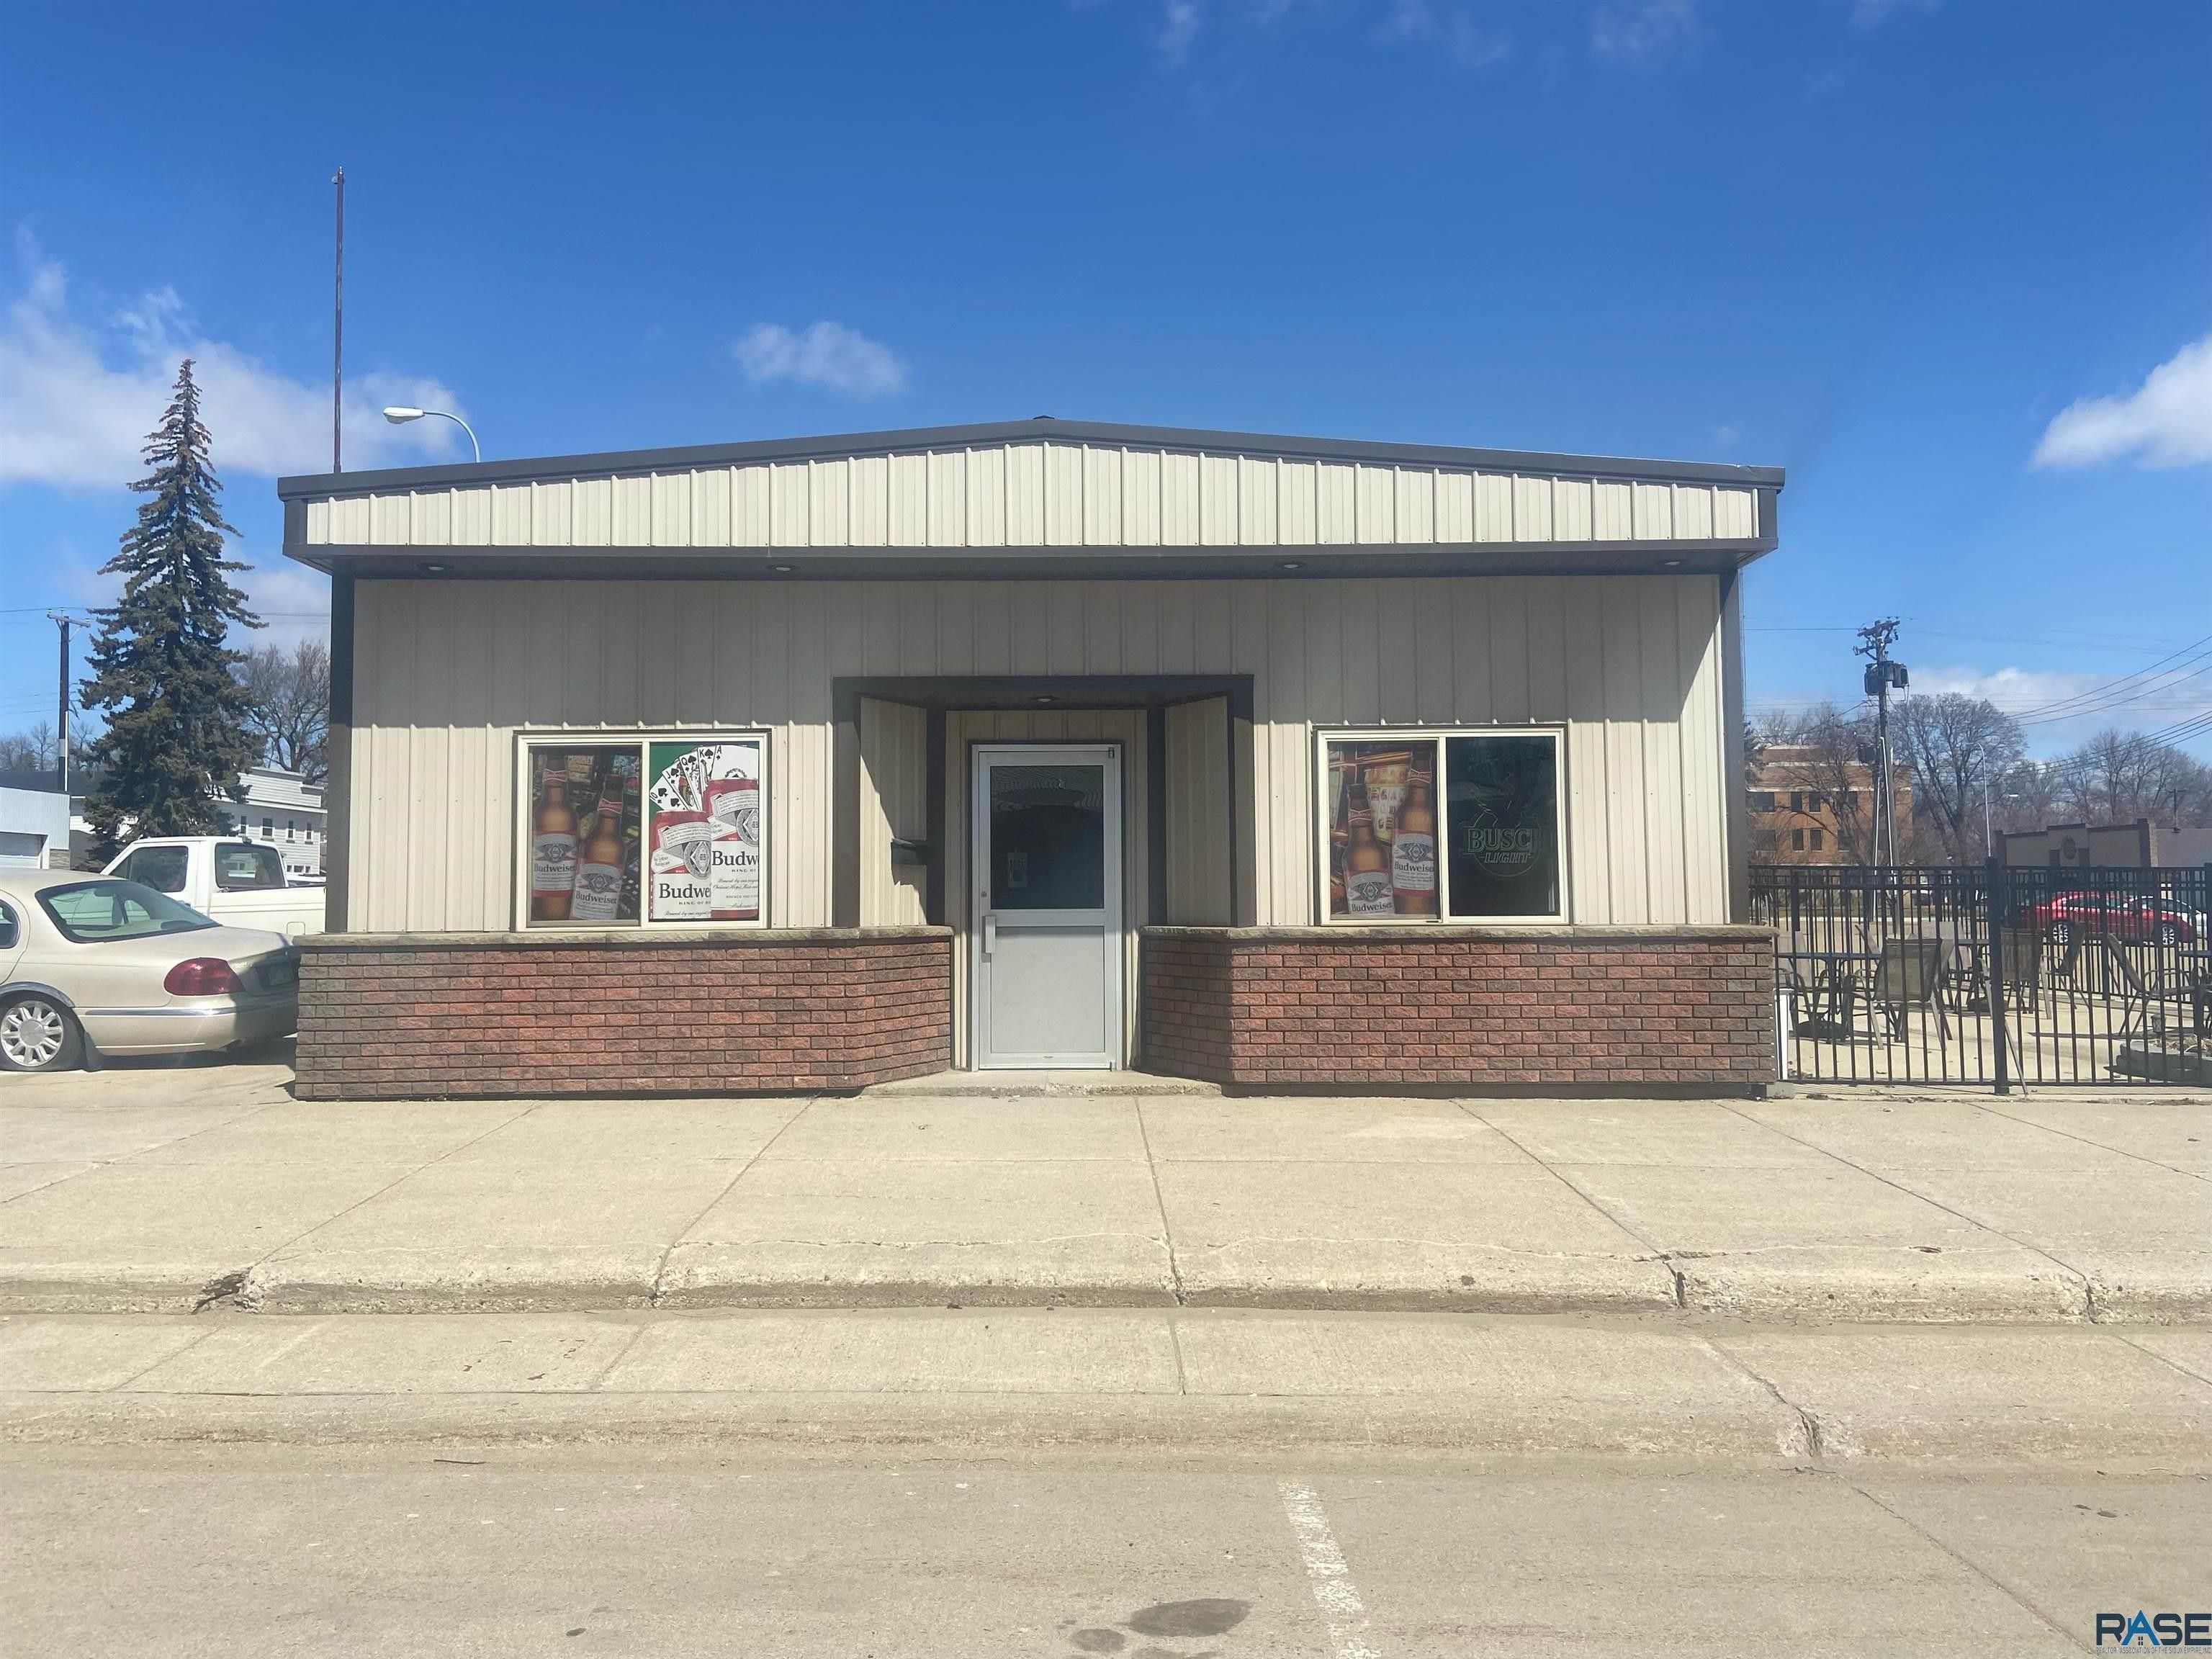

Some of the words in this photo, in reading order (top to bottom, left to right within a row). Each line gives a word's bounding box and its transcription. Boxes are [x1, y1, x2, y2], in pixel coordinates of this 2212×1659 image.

[699, 749, 705, 757] K
[681, 757, 689, 765] Q
[665, 770, 671, 779] J
[1467, 829, 1542, 852] BUSCH
[711, 850, 759, 866] Budw
[1484, 852, 1531, 863] LIGHT
[575, 891, 617, 904] Budweiser
